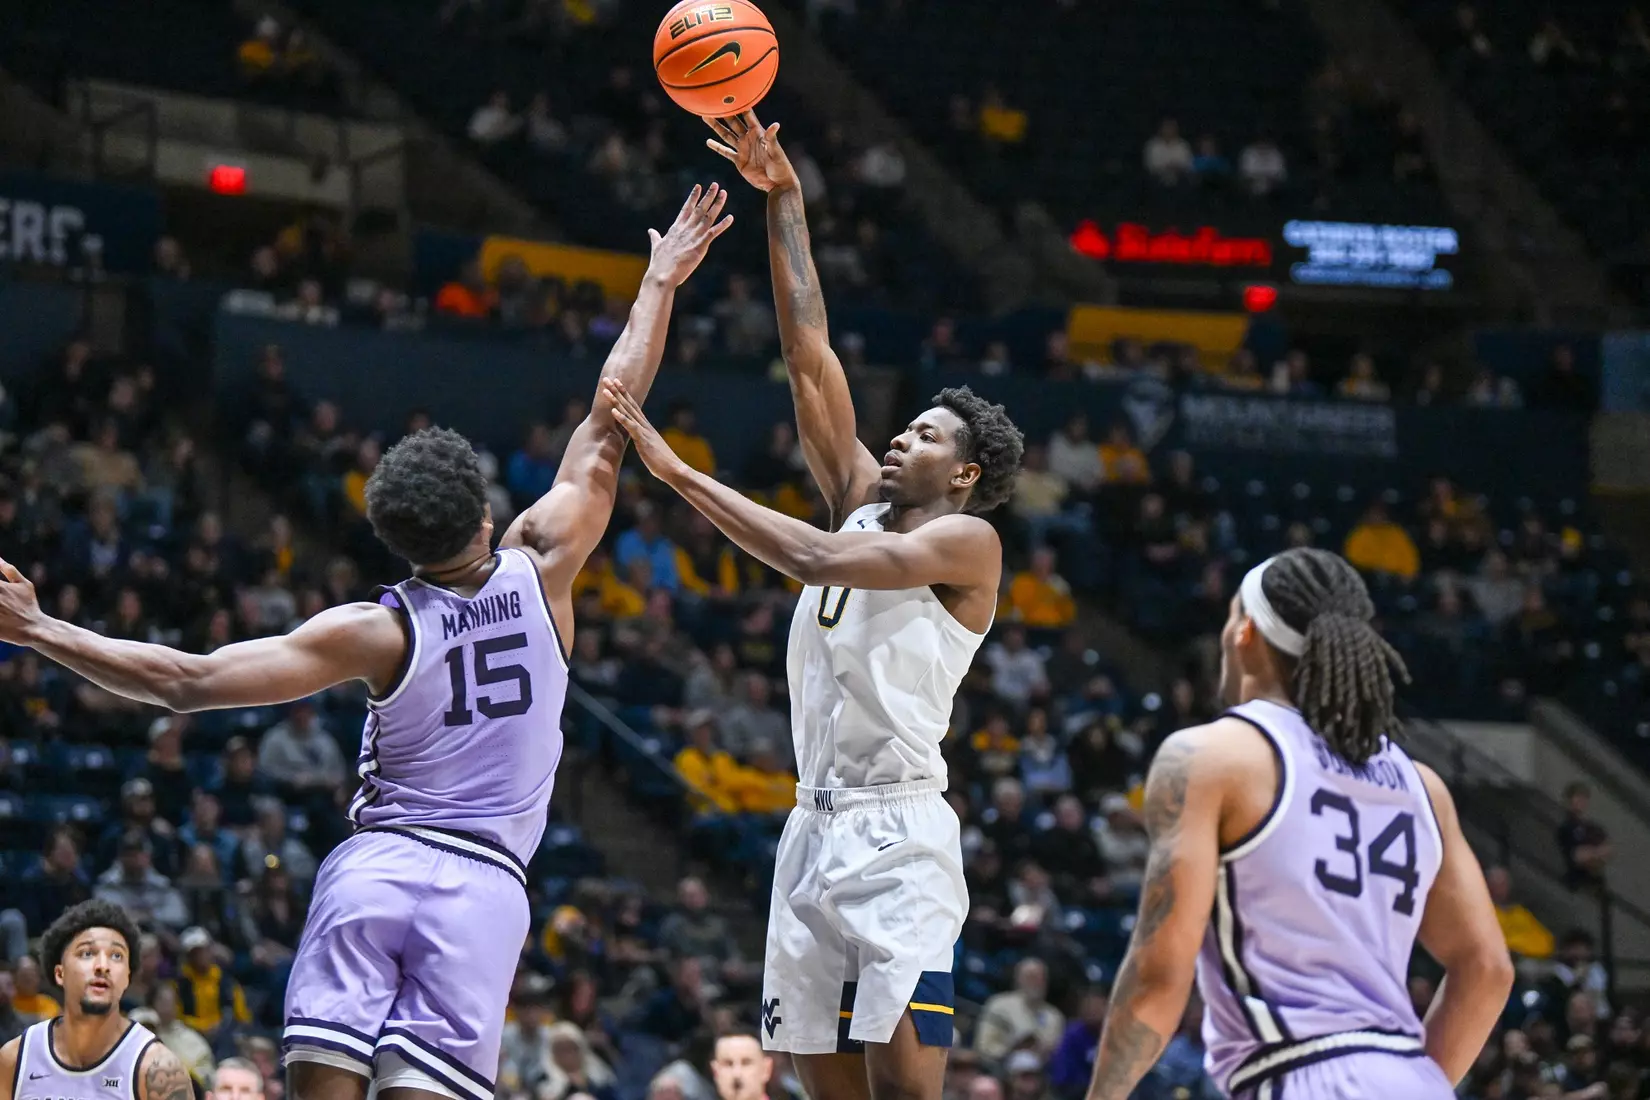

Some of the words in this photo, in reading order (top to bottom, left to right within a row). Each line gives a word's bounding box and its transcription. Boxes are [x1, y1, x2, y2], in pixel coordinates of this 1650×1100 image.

[669, 6, 734, 40] ELITE
[441, 590, 522, 640] MANNING
[444, 632, 533, 727] 15
[814, 789, 834, 812] WVU
[1310, 787, 1420, 917] 34
